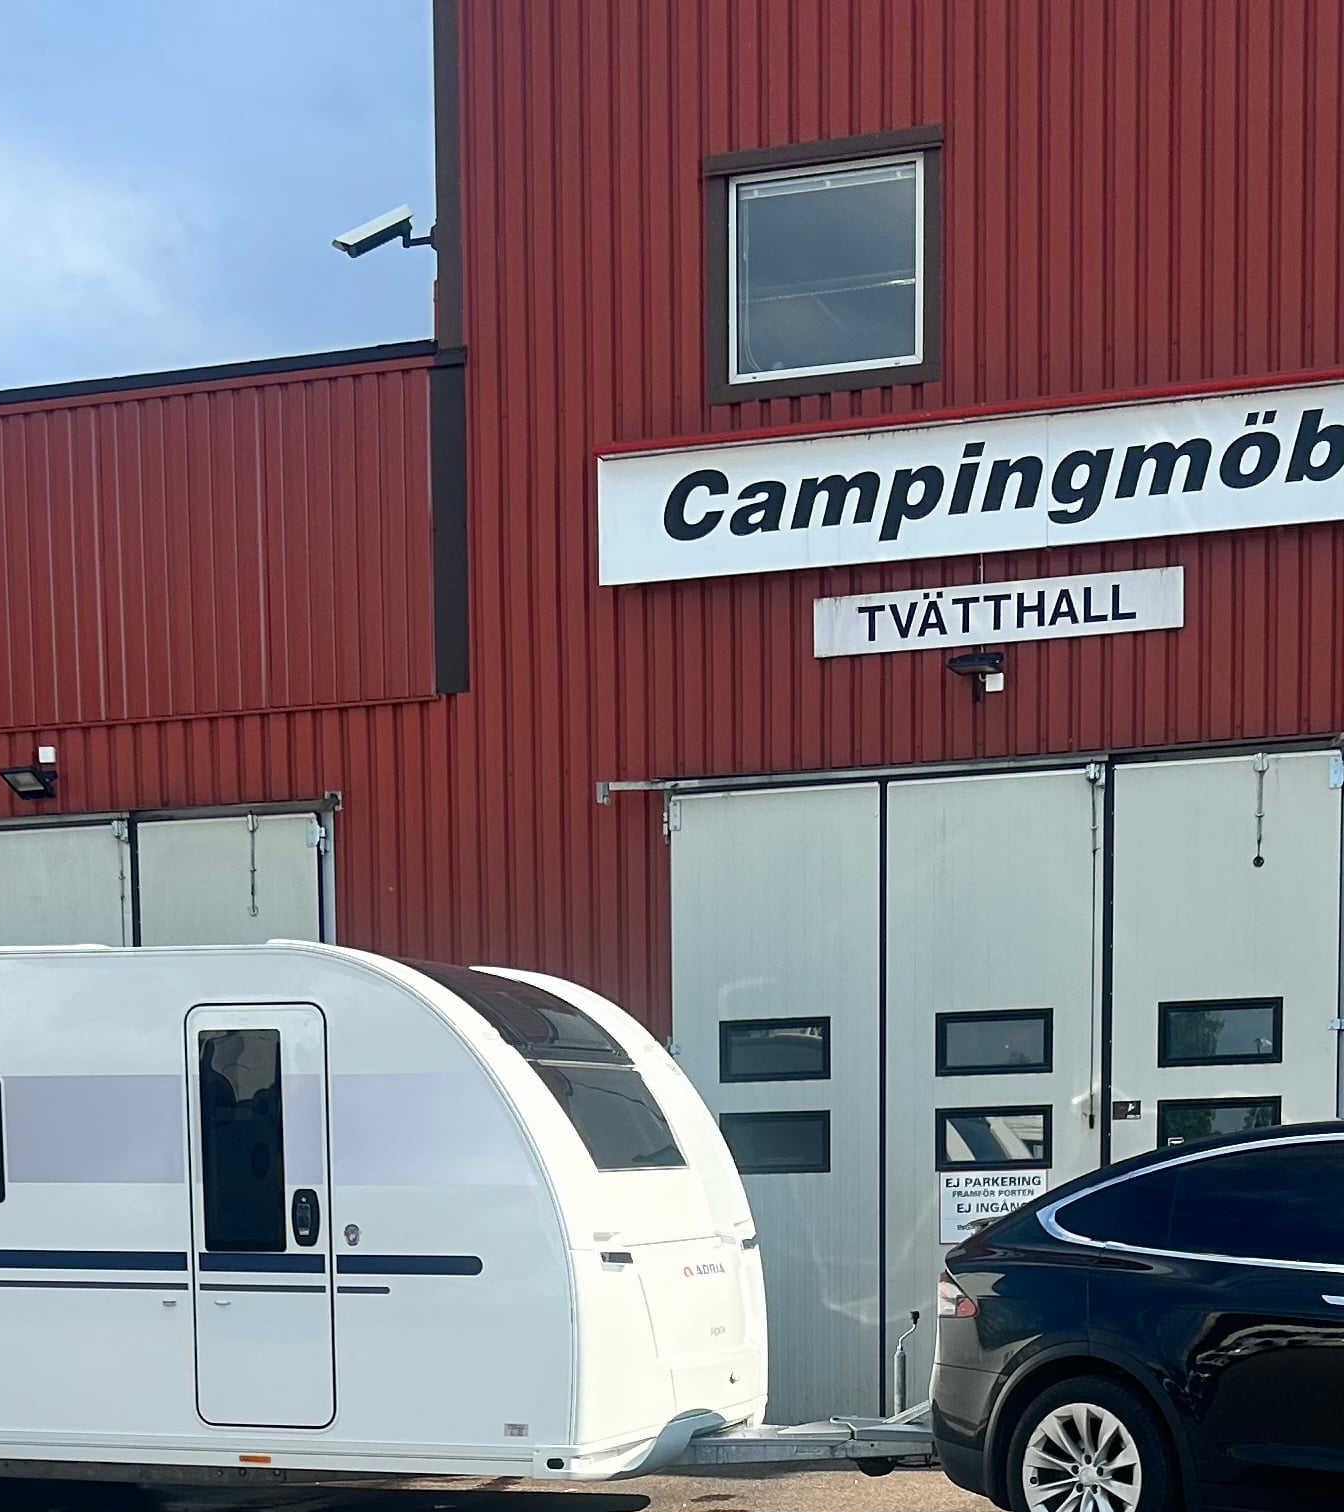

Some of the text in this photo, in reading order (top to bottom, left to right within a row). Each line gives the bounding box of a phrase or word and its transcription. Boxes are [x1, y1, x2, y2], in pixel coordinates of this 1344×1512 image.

[857, 583, 1137, 642] TVÄTTHALL
[945, 1176, 1042, 1188] EJ PARKERING
[952, 1188, 1035, 1198] FRAMFÖR PORTEN
[956, 1202, 972, 1213] EJ
